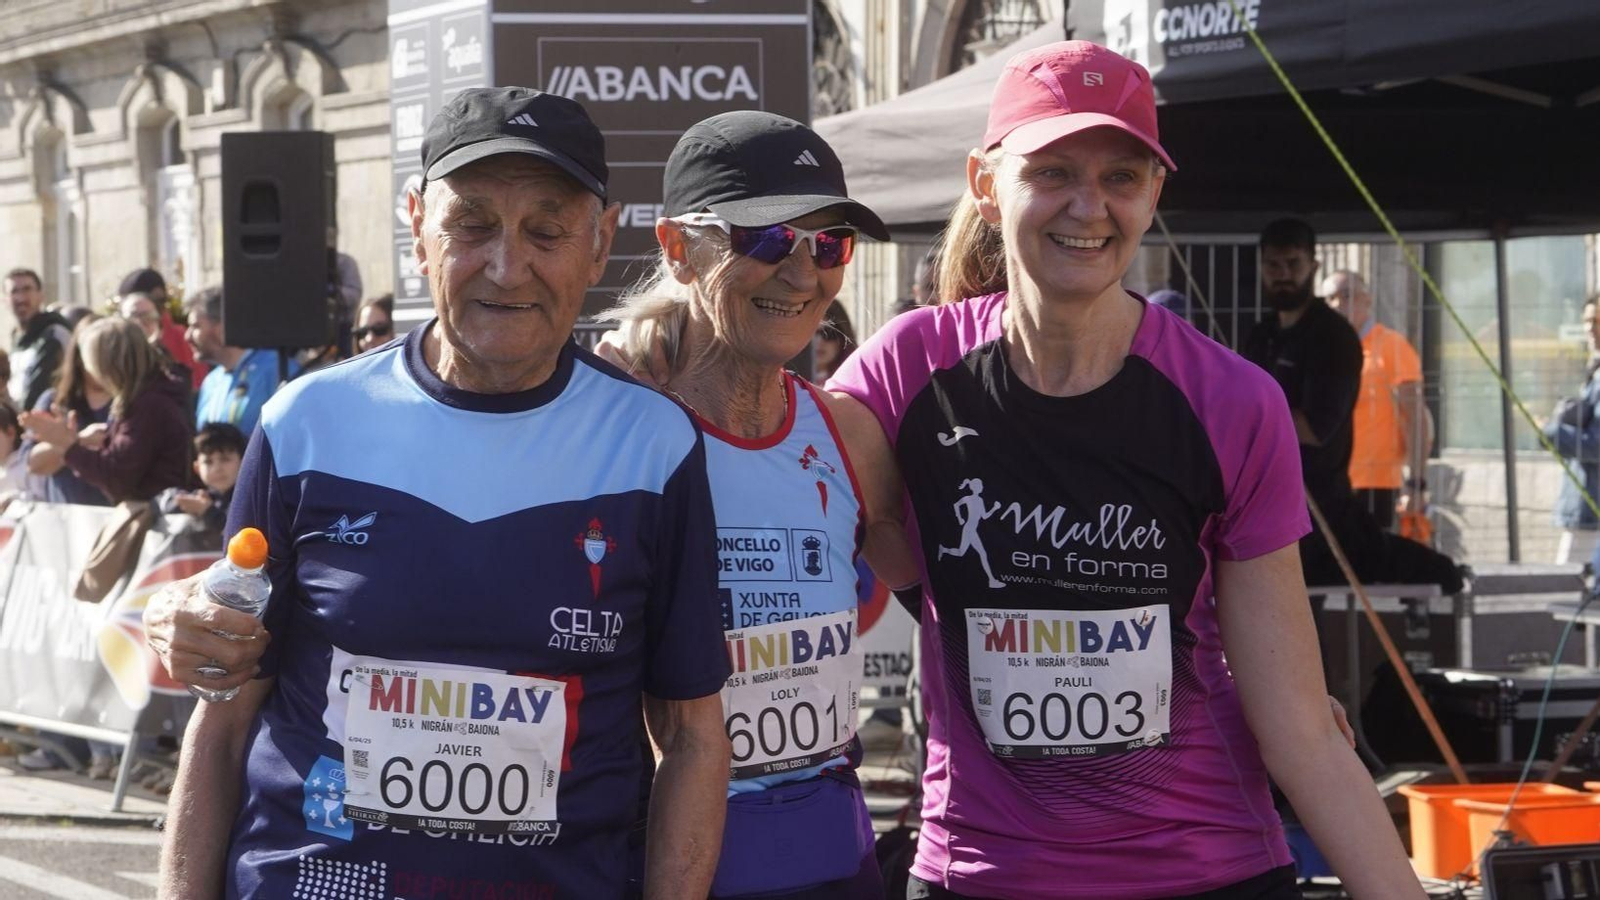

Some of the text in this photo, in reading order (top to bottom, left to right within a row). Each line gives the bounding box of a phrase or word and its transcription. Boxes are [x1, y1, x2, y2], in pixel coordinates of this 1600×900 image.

[1154, 0, 1260, 43] CCNORTE
[1000, 501, 1166, 550] Muller
[735, 558, 774, 572] VIGO
[1011, 551, 1167, 579] en forma
[1000, 574, 1167, 595] www.mullerenforma.com
[739, 592, 801, 608] XUNTA
[550, 606, 623, 637] CELTA
[985, 615, 1157, 653] MINIBAY
[1007, 655, 1109, 668] 10,5 k NIGRÁN BAIONA
[741, 677, 747, 686] k
[752, 669, 779, 684] NIGRÁN
[791, 665, 819, 678] BAIONA
[1055, 677, 1092, 688] PAULI
[368, 674, 553, 724] MINIBAY
[771, 687, 800, 701] LOLY
[392, 717, 500, 736] 10,5 k NIGRÁN BAIONA
[1003, 691, 1145, 741] 6003
[725, 694, 839, 762] 6001
[435, 743, 482, 757] JAVIER
[1051, 747, 1070, 755] TODA
[1071, 746, 1096, 755] COSTA!
[772, 763, 790, 772] TODA
[380, 756, 530, 816] 6000
[428, 819, 447, 829] TODA
[449, 821, 476, 831] COSTA!
